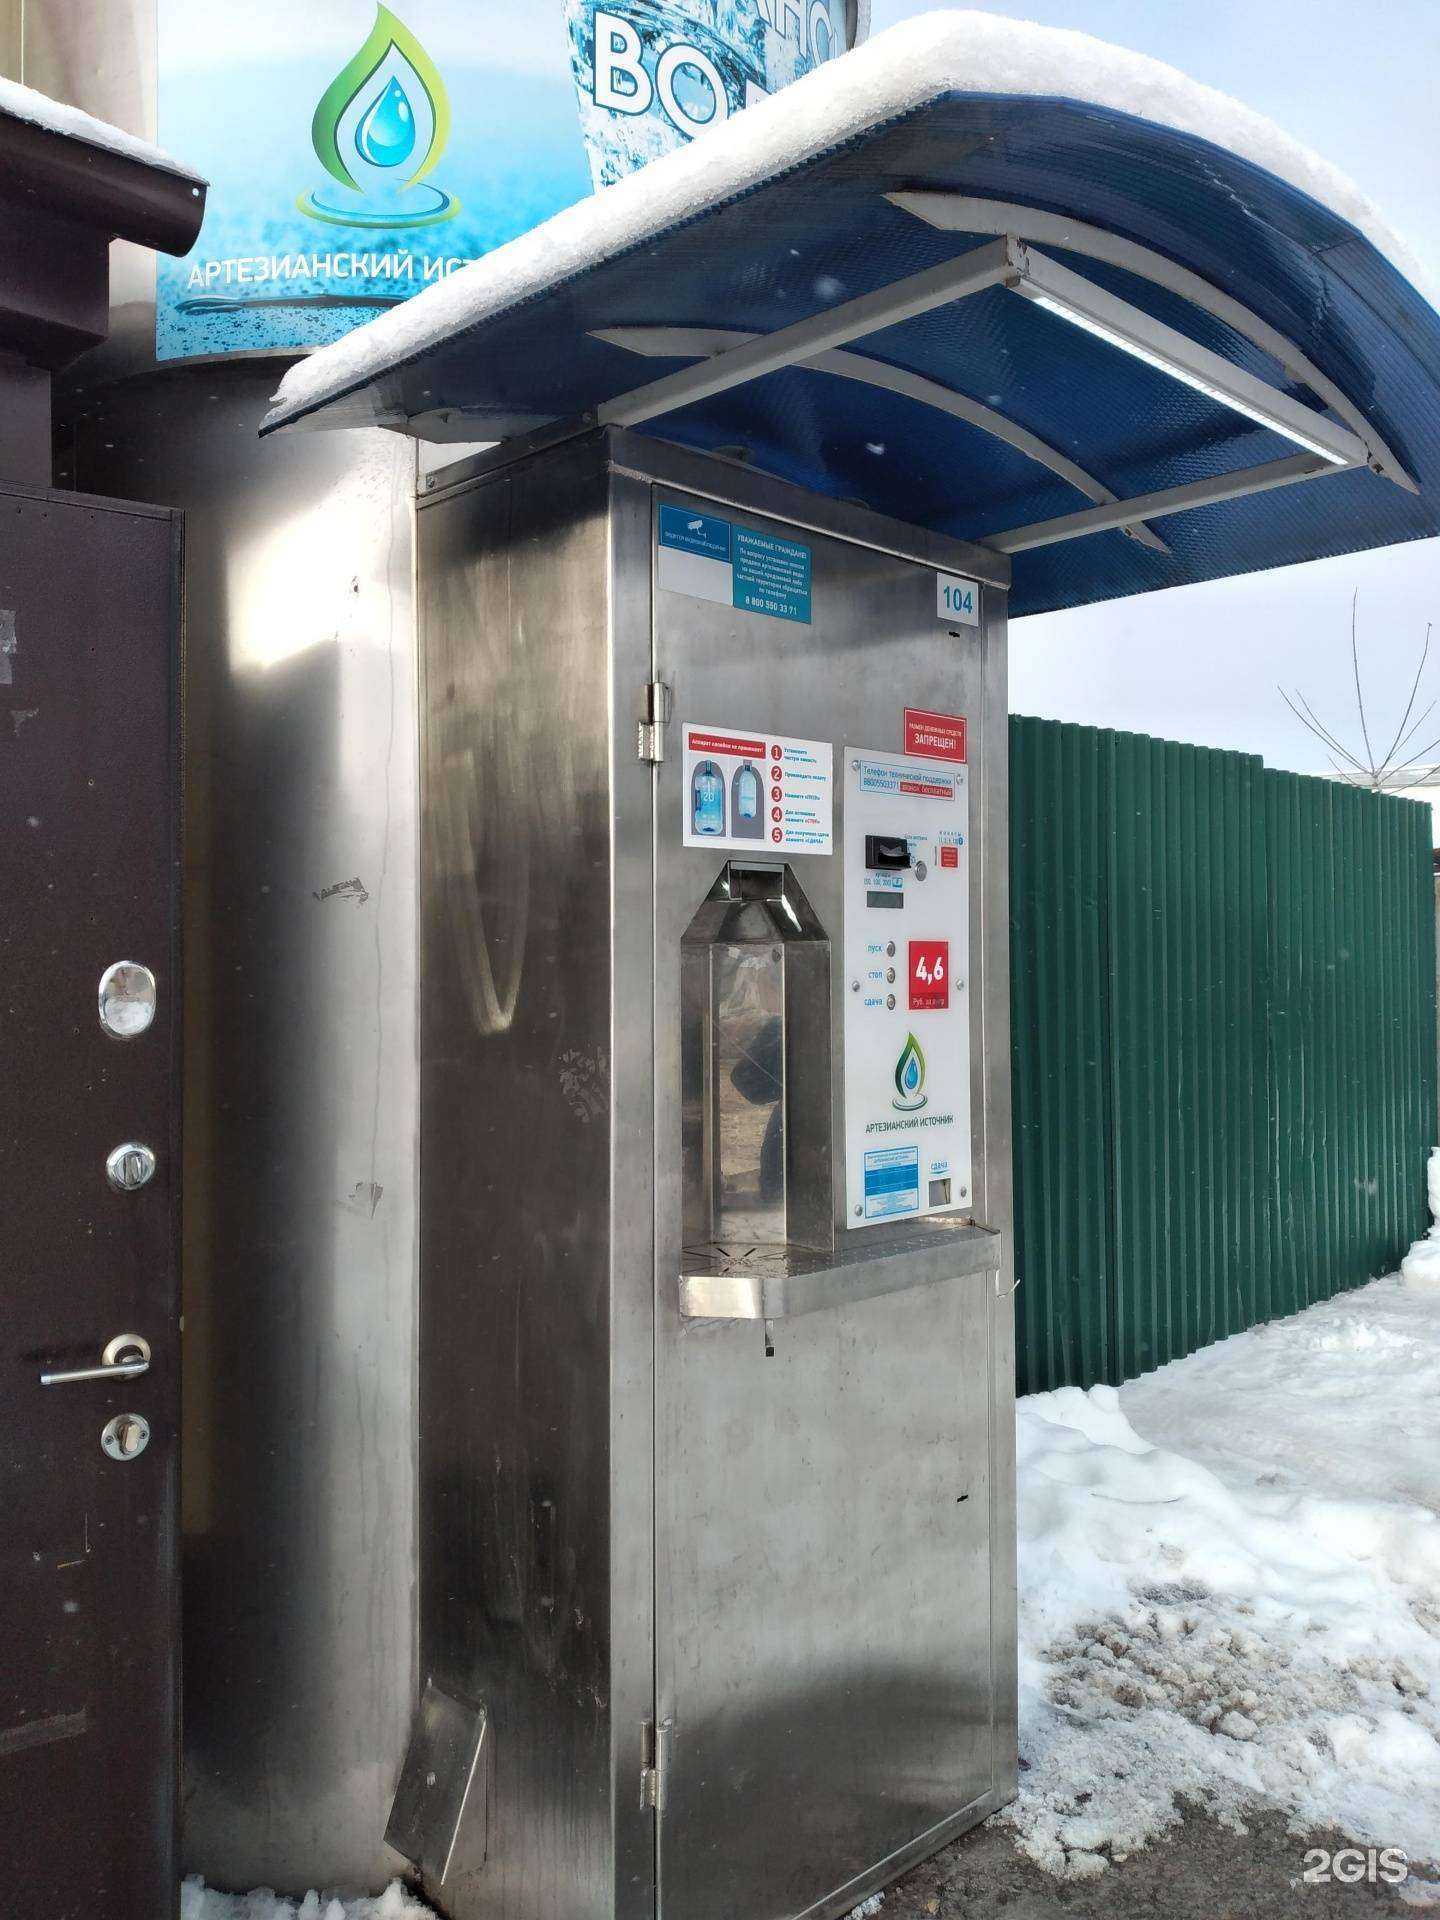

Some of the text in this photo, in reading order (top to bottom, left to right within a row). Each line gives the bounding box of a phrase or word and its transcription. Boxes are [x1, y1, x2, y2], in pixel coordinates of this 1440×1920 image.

[593, 9, 772, 142] ВО
[188, 249, 412, 289] АРТЕЗИАНСКИЙ
[737, 534, 774, 551] УВАЖАЕМЫЕ
[745, 595, 797, 615] 8 800 550 33 71
[943, 584, 973, 614] 104
[914, 733, 956, 750] ЗАПРЕЩЕН!
[774, 747, 780, 759] 1
[773, 768, 780, 780] 2
[863, 766, 952, 785] Телефон технической поддержки
[774, 789, 780, 801] 3
[774, 809, 780, 821] 4
[774, 829, 780, 841] 5
[867, 944, 883, 954] пуск
[915, 956, 944, 986] 4,6
[865, 1114, 954, 1133] АРТЕЗИАНСКИЙ ИСТОЧНИК
[930, 1161, 948, 1170] сдача
